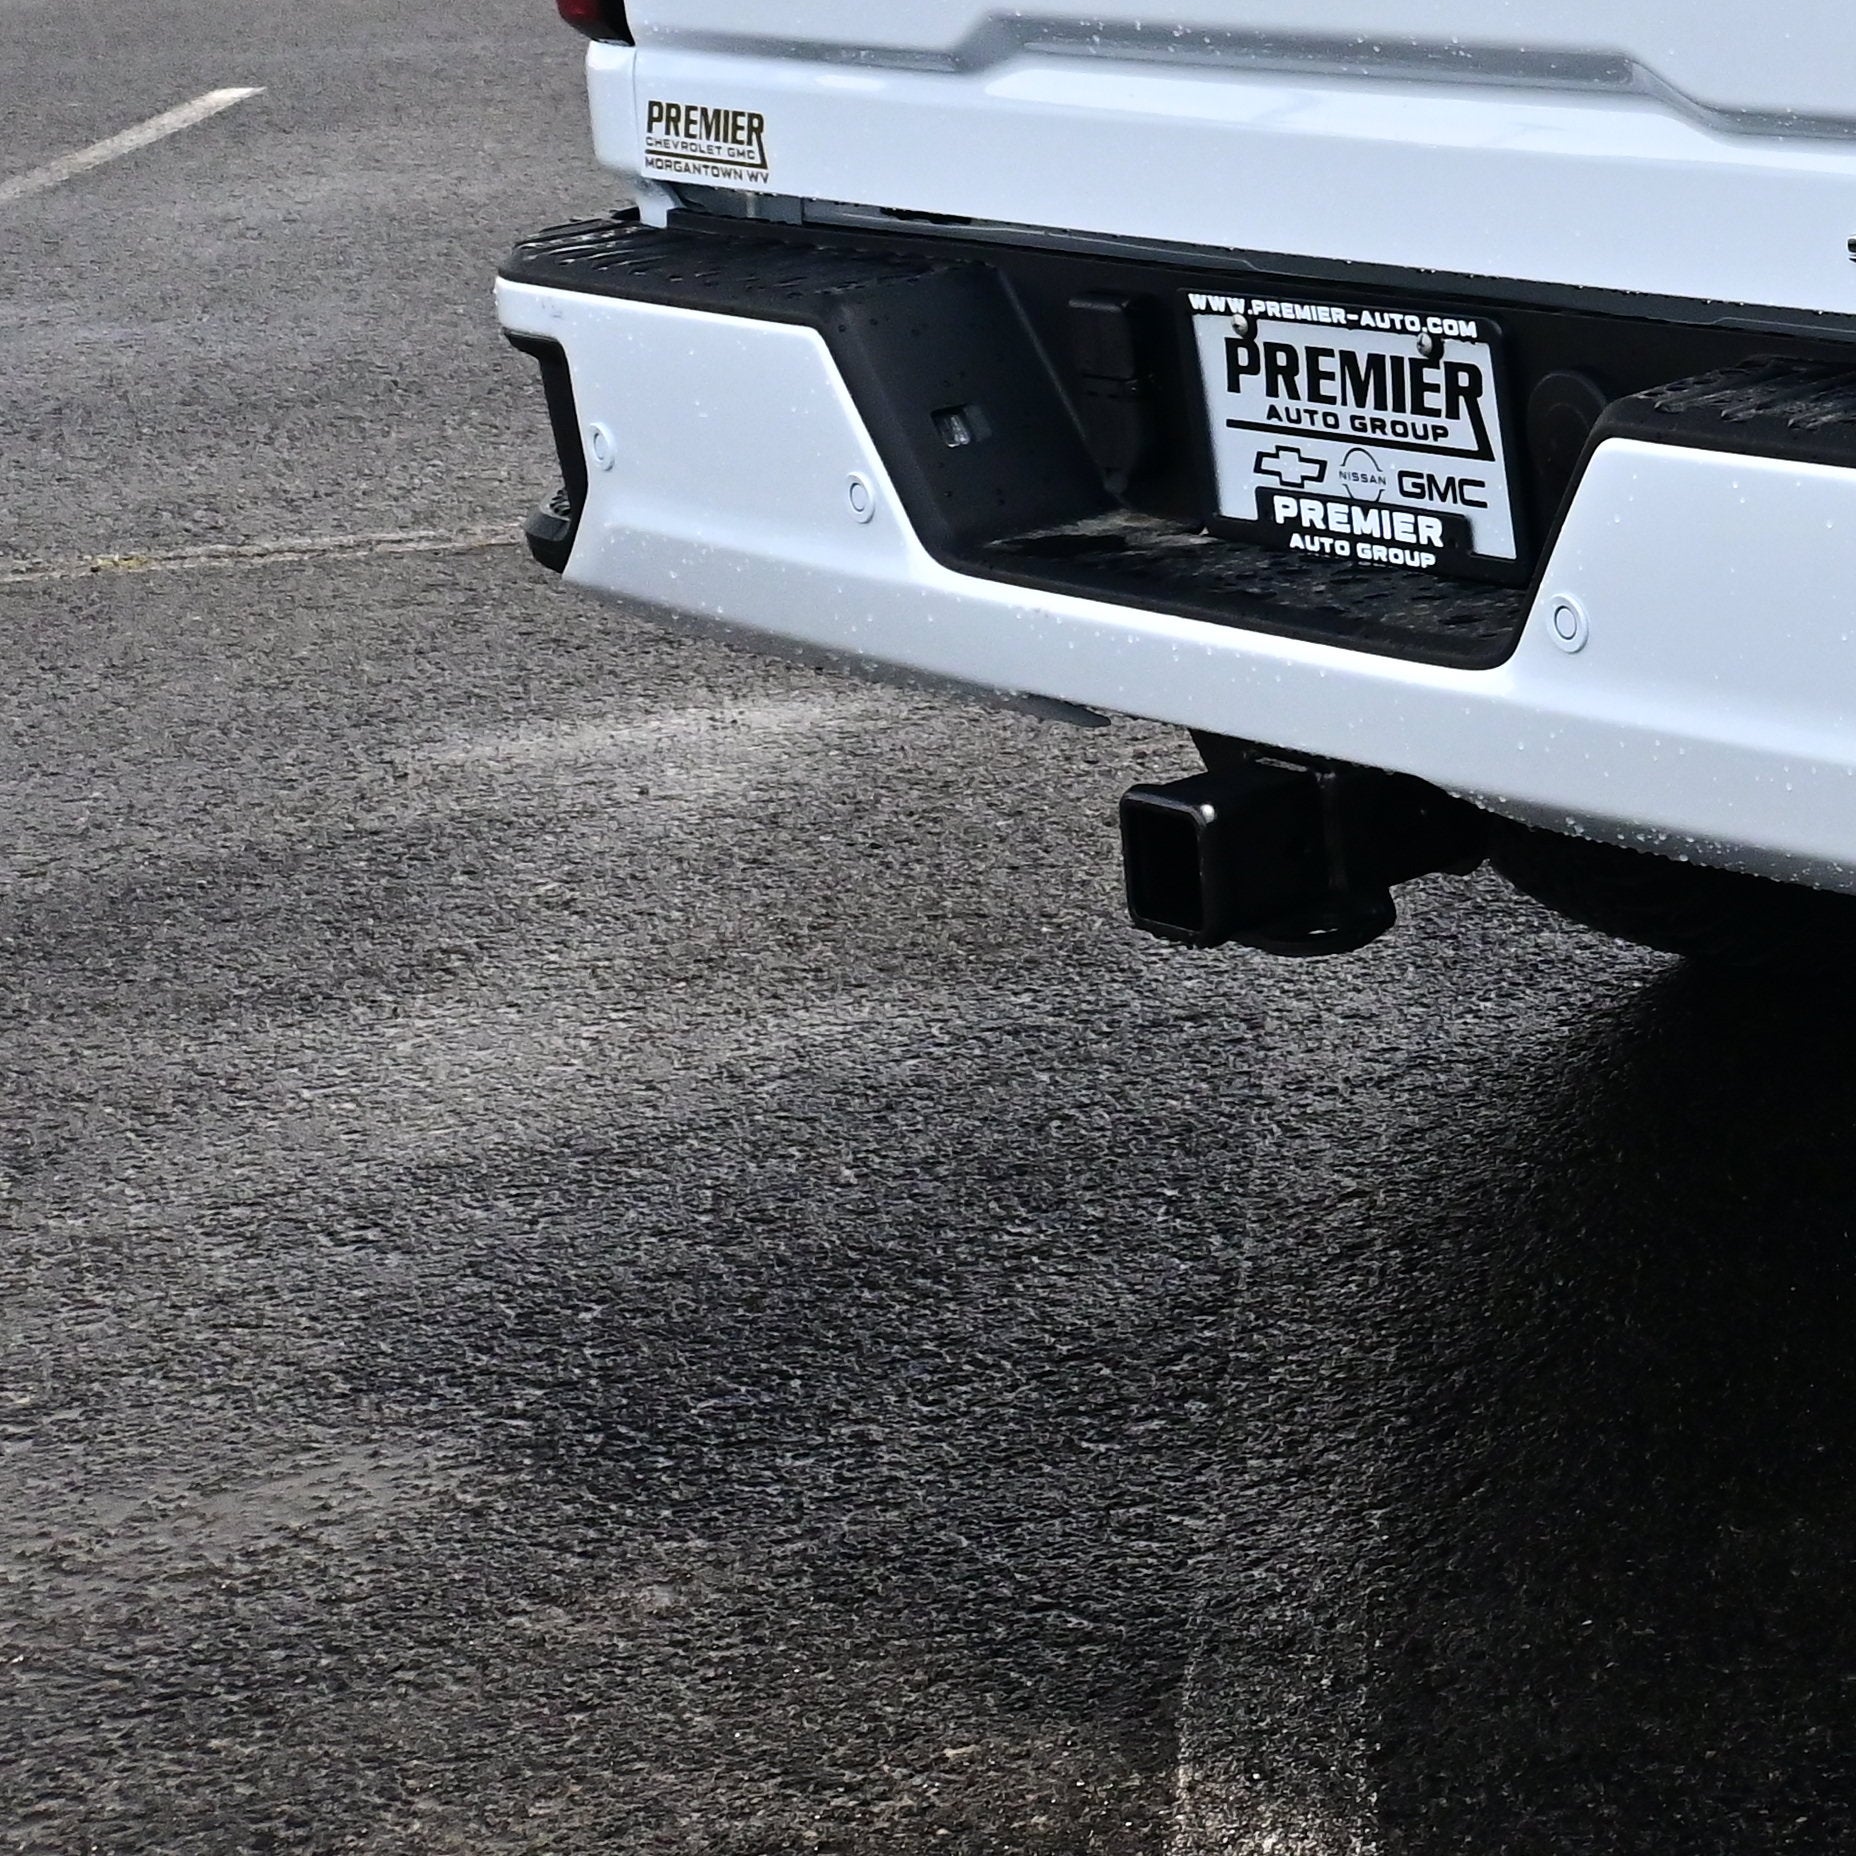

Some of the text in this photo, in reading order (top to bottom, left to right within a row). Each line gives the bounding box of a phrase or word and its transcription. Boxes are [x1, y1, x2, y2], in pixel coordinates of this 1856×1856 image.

[647, 100, 765, 147] PREMIER
[645, 136, 756, 160] CHEVROLET GMC
[645, 157, 769, 184] MORGANTOWN WV
[1188, 293, 1478, 338] WWW.PREMIER-AUTO.COM
[1225, 336, 1486, 424] PREMIER
[1266, 404, 1450, 442] AUTO GROUP
[1338, 469, 1489, 509] NISSAN GMC
[1273, 495, 1444, 548] PREMIER
[1290, 532, 1436, 569] AUTO GROUP
